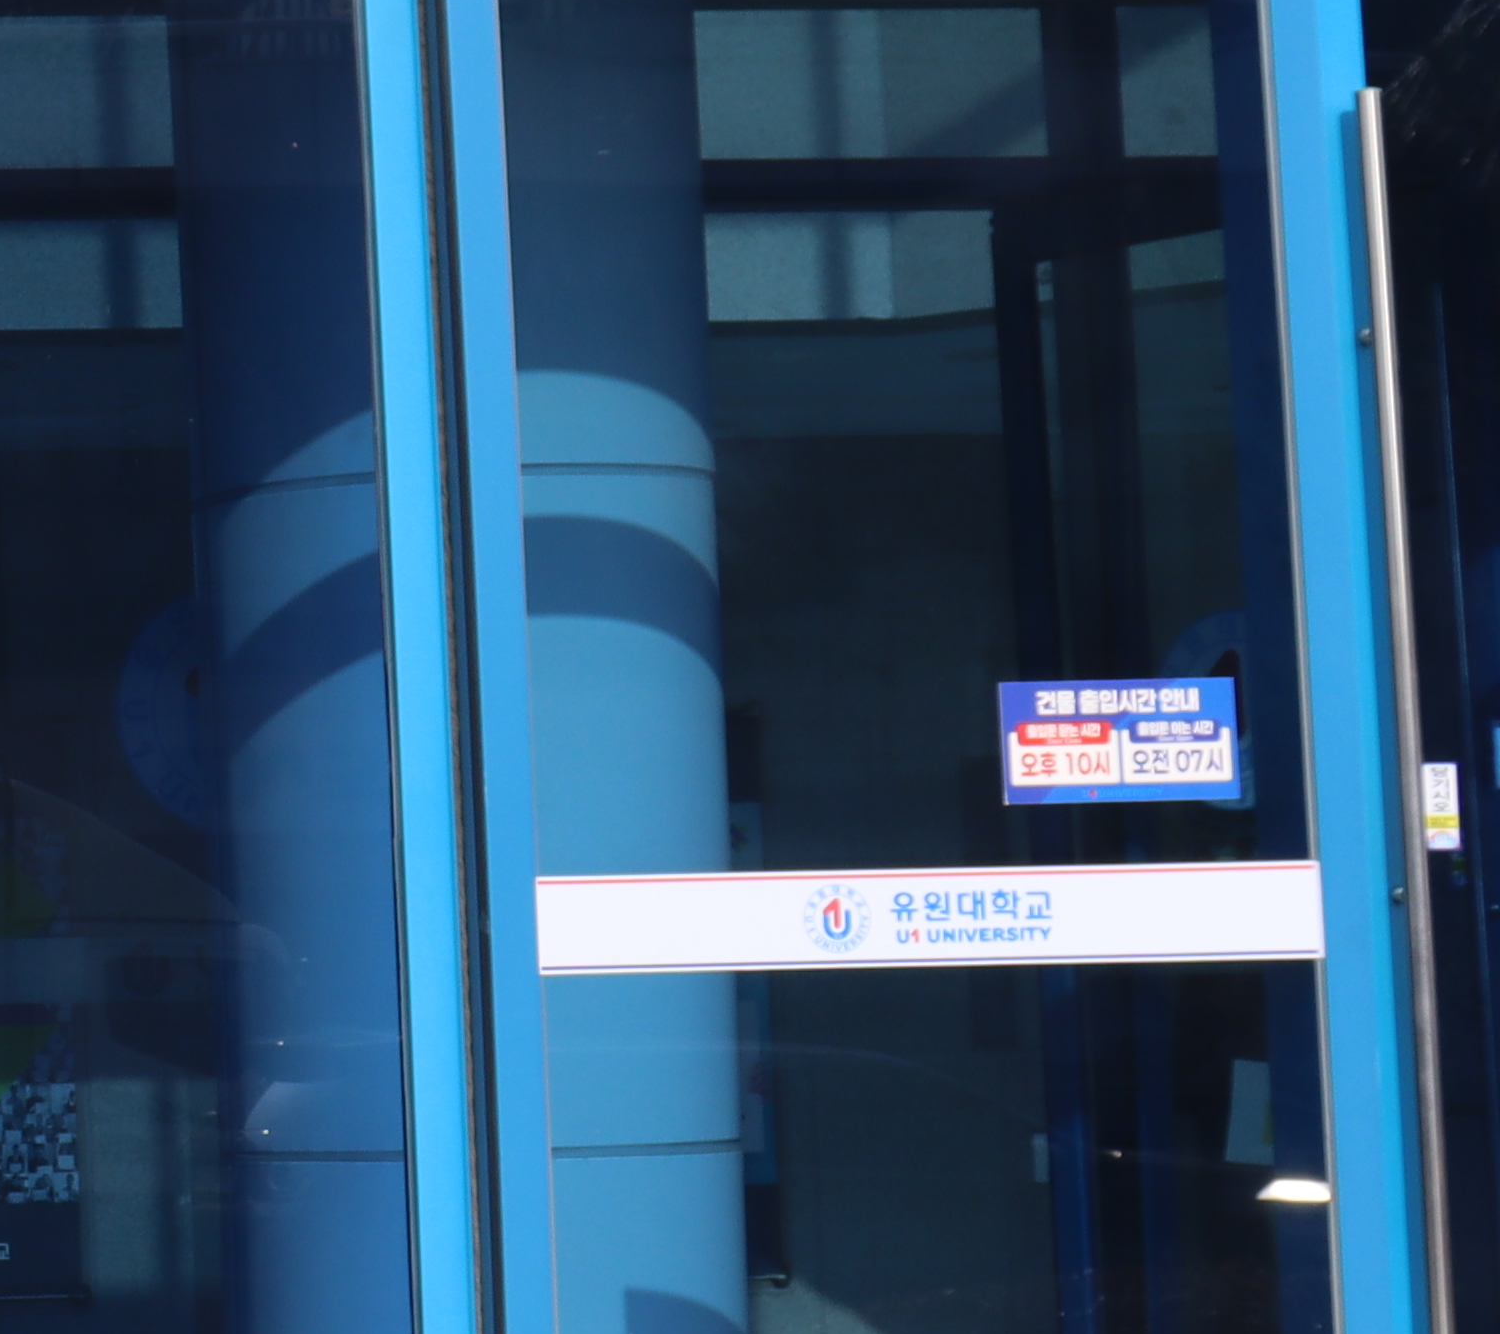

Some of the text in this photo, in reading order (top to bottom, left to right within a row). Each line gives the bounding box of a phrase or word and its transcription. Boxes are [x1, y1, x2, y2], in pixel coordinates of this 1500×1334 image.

[1158, 686, 1200, 713] 안내
[1021, 750, 1111, 777] 오후 10시
[1132, 748, 1224, 774] 오전 07시
[890, 889, 1053, 922] 유원대학교
[896, 926, 1052, 944] U1 UNIVERSITY
